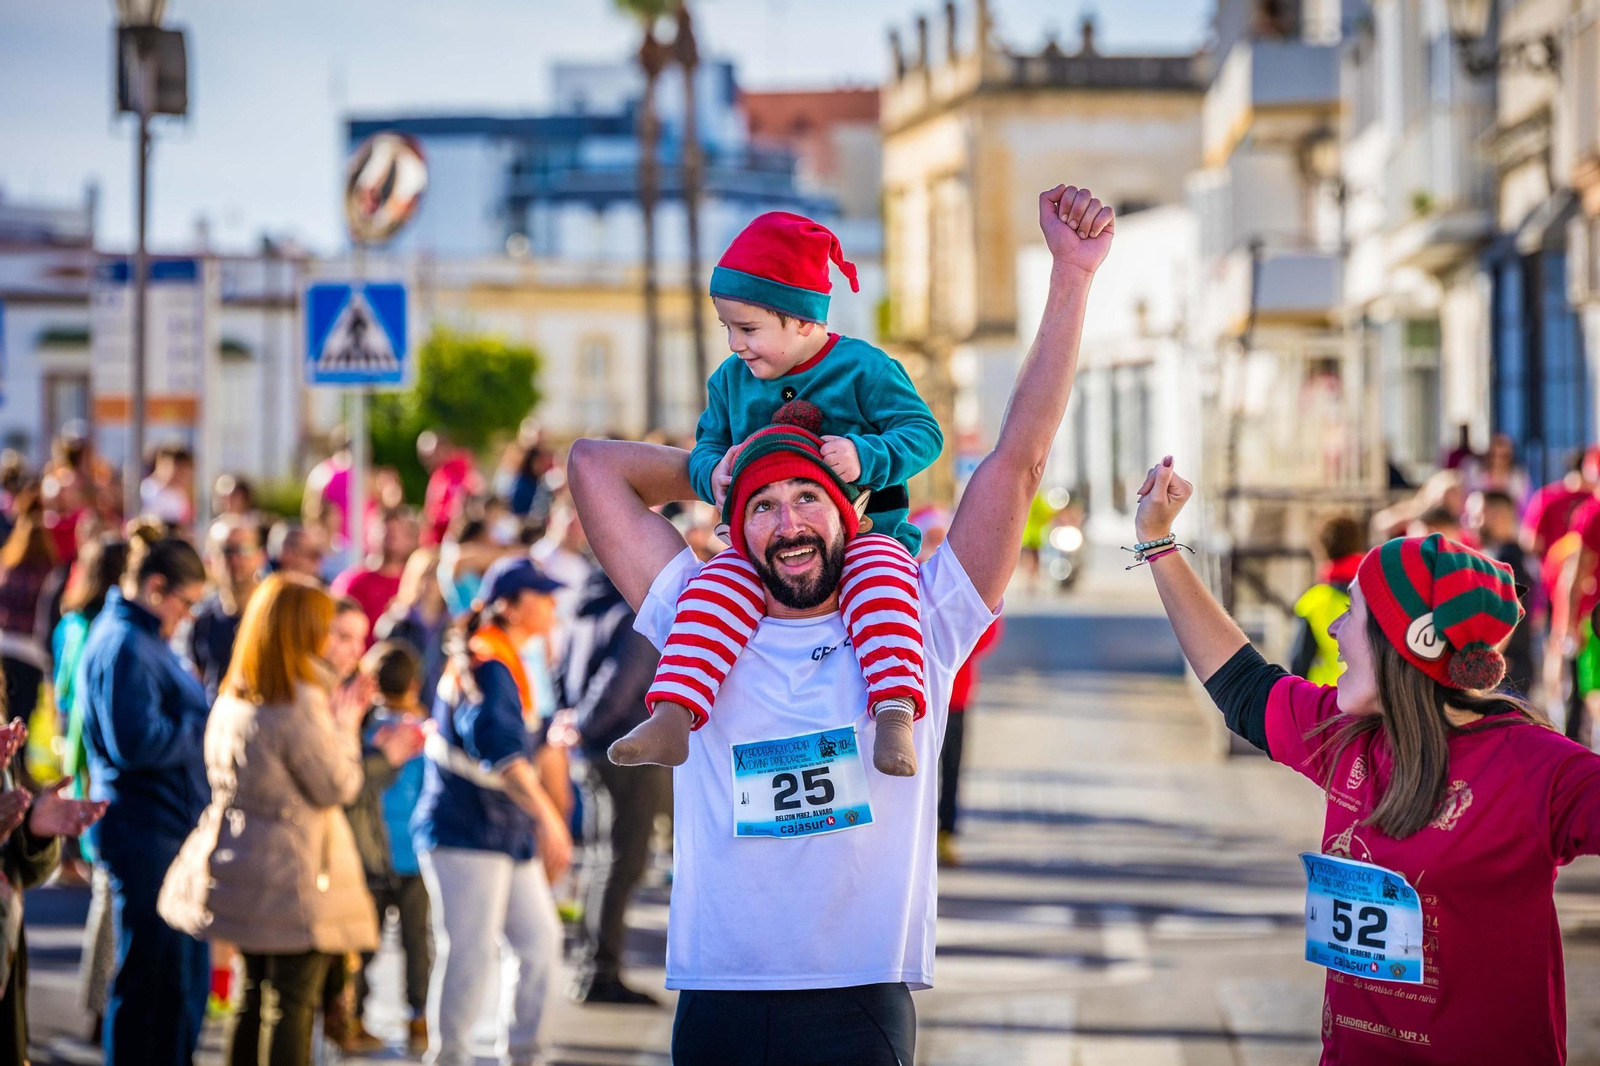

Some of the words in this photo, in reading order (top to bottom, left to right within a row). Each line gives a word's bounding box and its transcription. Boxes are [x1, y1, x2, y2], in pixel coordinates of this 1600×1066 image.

[772, 766, 835, 811] 25
[775, 813, 795, 822] BELIZON
[813, 807, 834, 817] ALVARO
[780, 820, 825, 835] cajasur
[1332, 898, 1388, 950] 52
[1334, 955, 1369, 973] cajasur
[1364, 982, 1394, 996] sonrisa
[1394, 987, 1406, 998] de
[1406, 992, 1418, 1001] un
[1399, 1029, 1418, 1041] SUR
